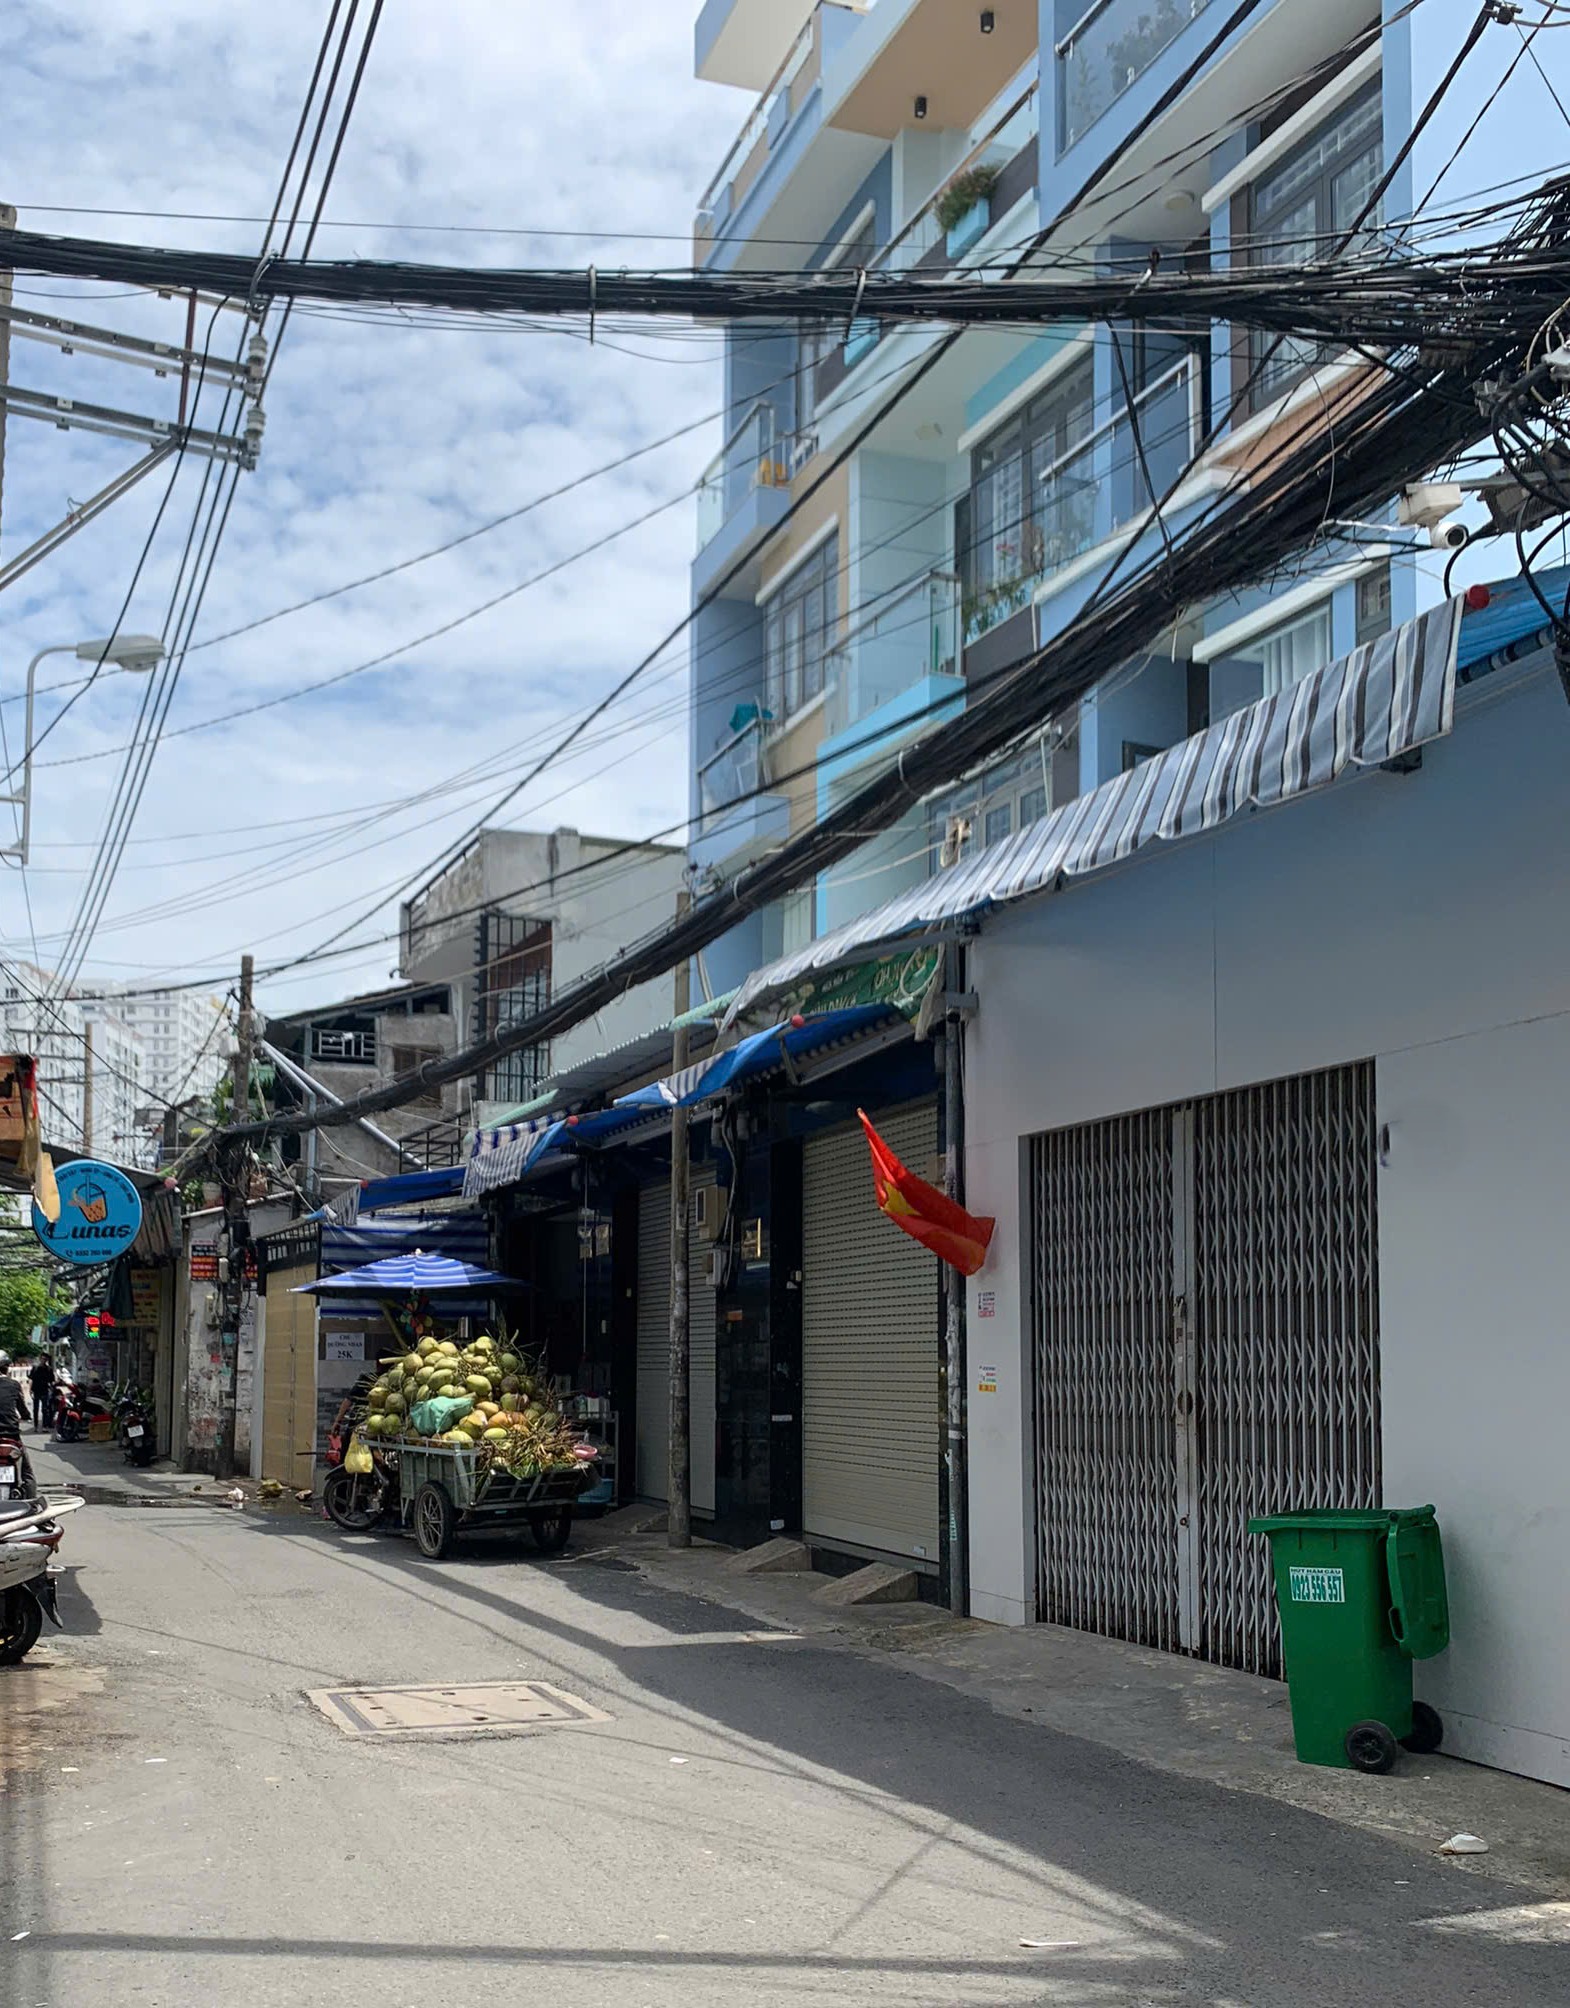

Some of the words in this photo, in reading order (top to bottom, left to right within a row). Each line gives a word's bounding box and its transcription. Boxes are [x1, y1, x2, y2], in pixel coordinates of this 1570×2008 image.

[42, 1222, 132, 1239] Lunas
[338, 1350, 352, 1358] 25K
[1292, 1575, 1310, 1600] 0923
[1327, 1576, 1342, 1601] 557
